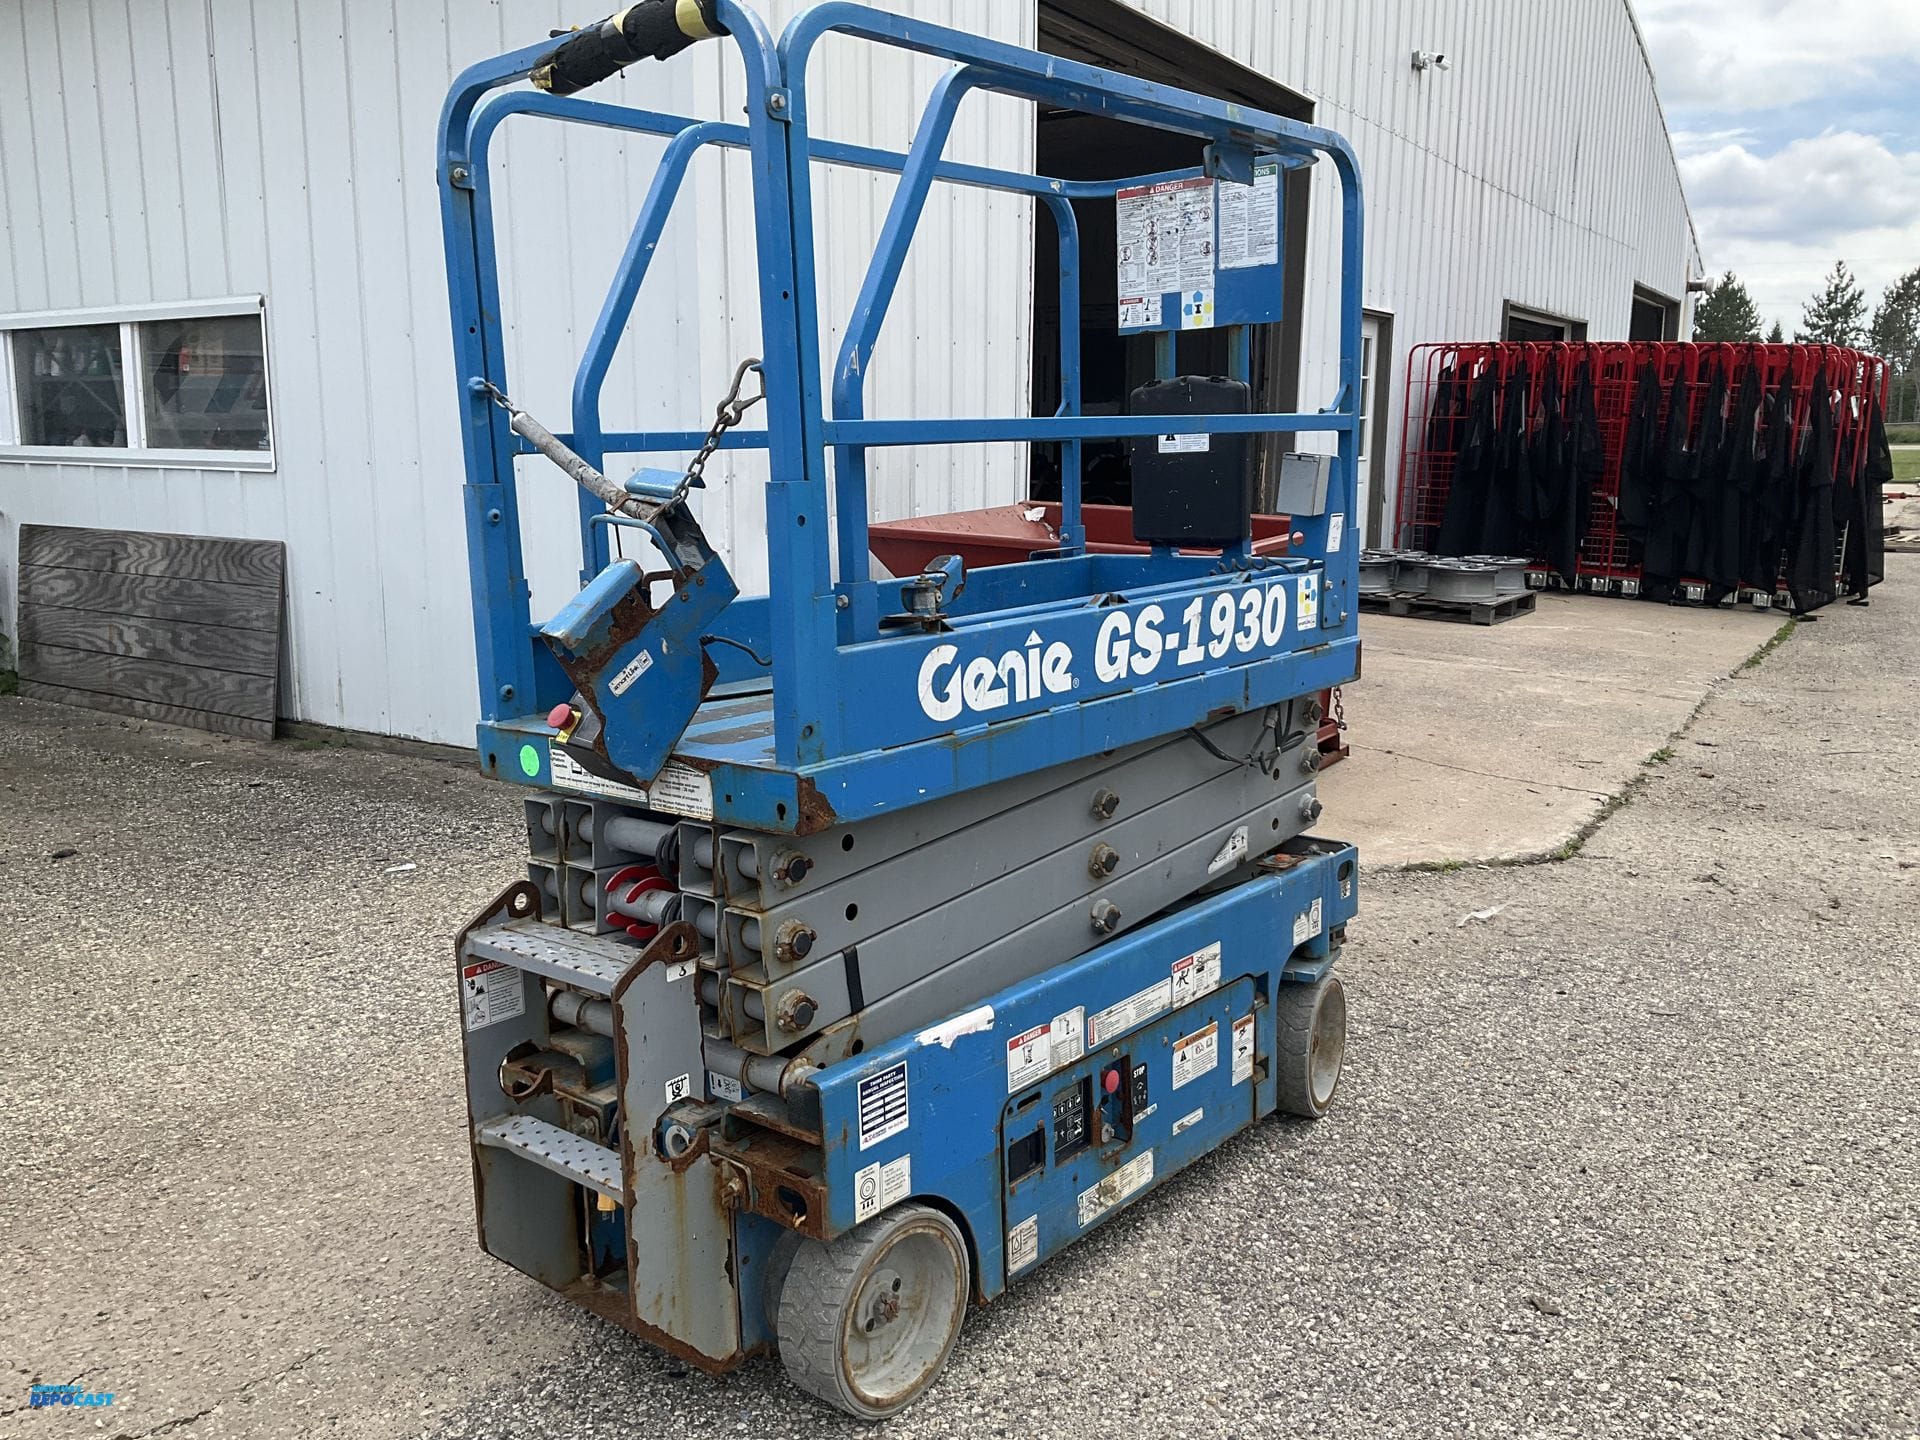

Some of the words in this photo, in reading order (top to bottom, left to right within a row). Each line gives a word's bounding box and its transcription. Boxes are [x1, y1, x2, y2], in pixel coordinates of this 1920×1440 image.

[1155, 182, 1184, 193] DANGER
[1094, 584, 1287, 684] GS-1930
[882, 1070, 897, 1081] PARTY
[1133, 1065, 1146, 1079] STOP
